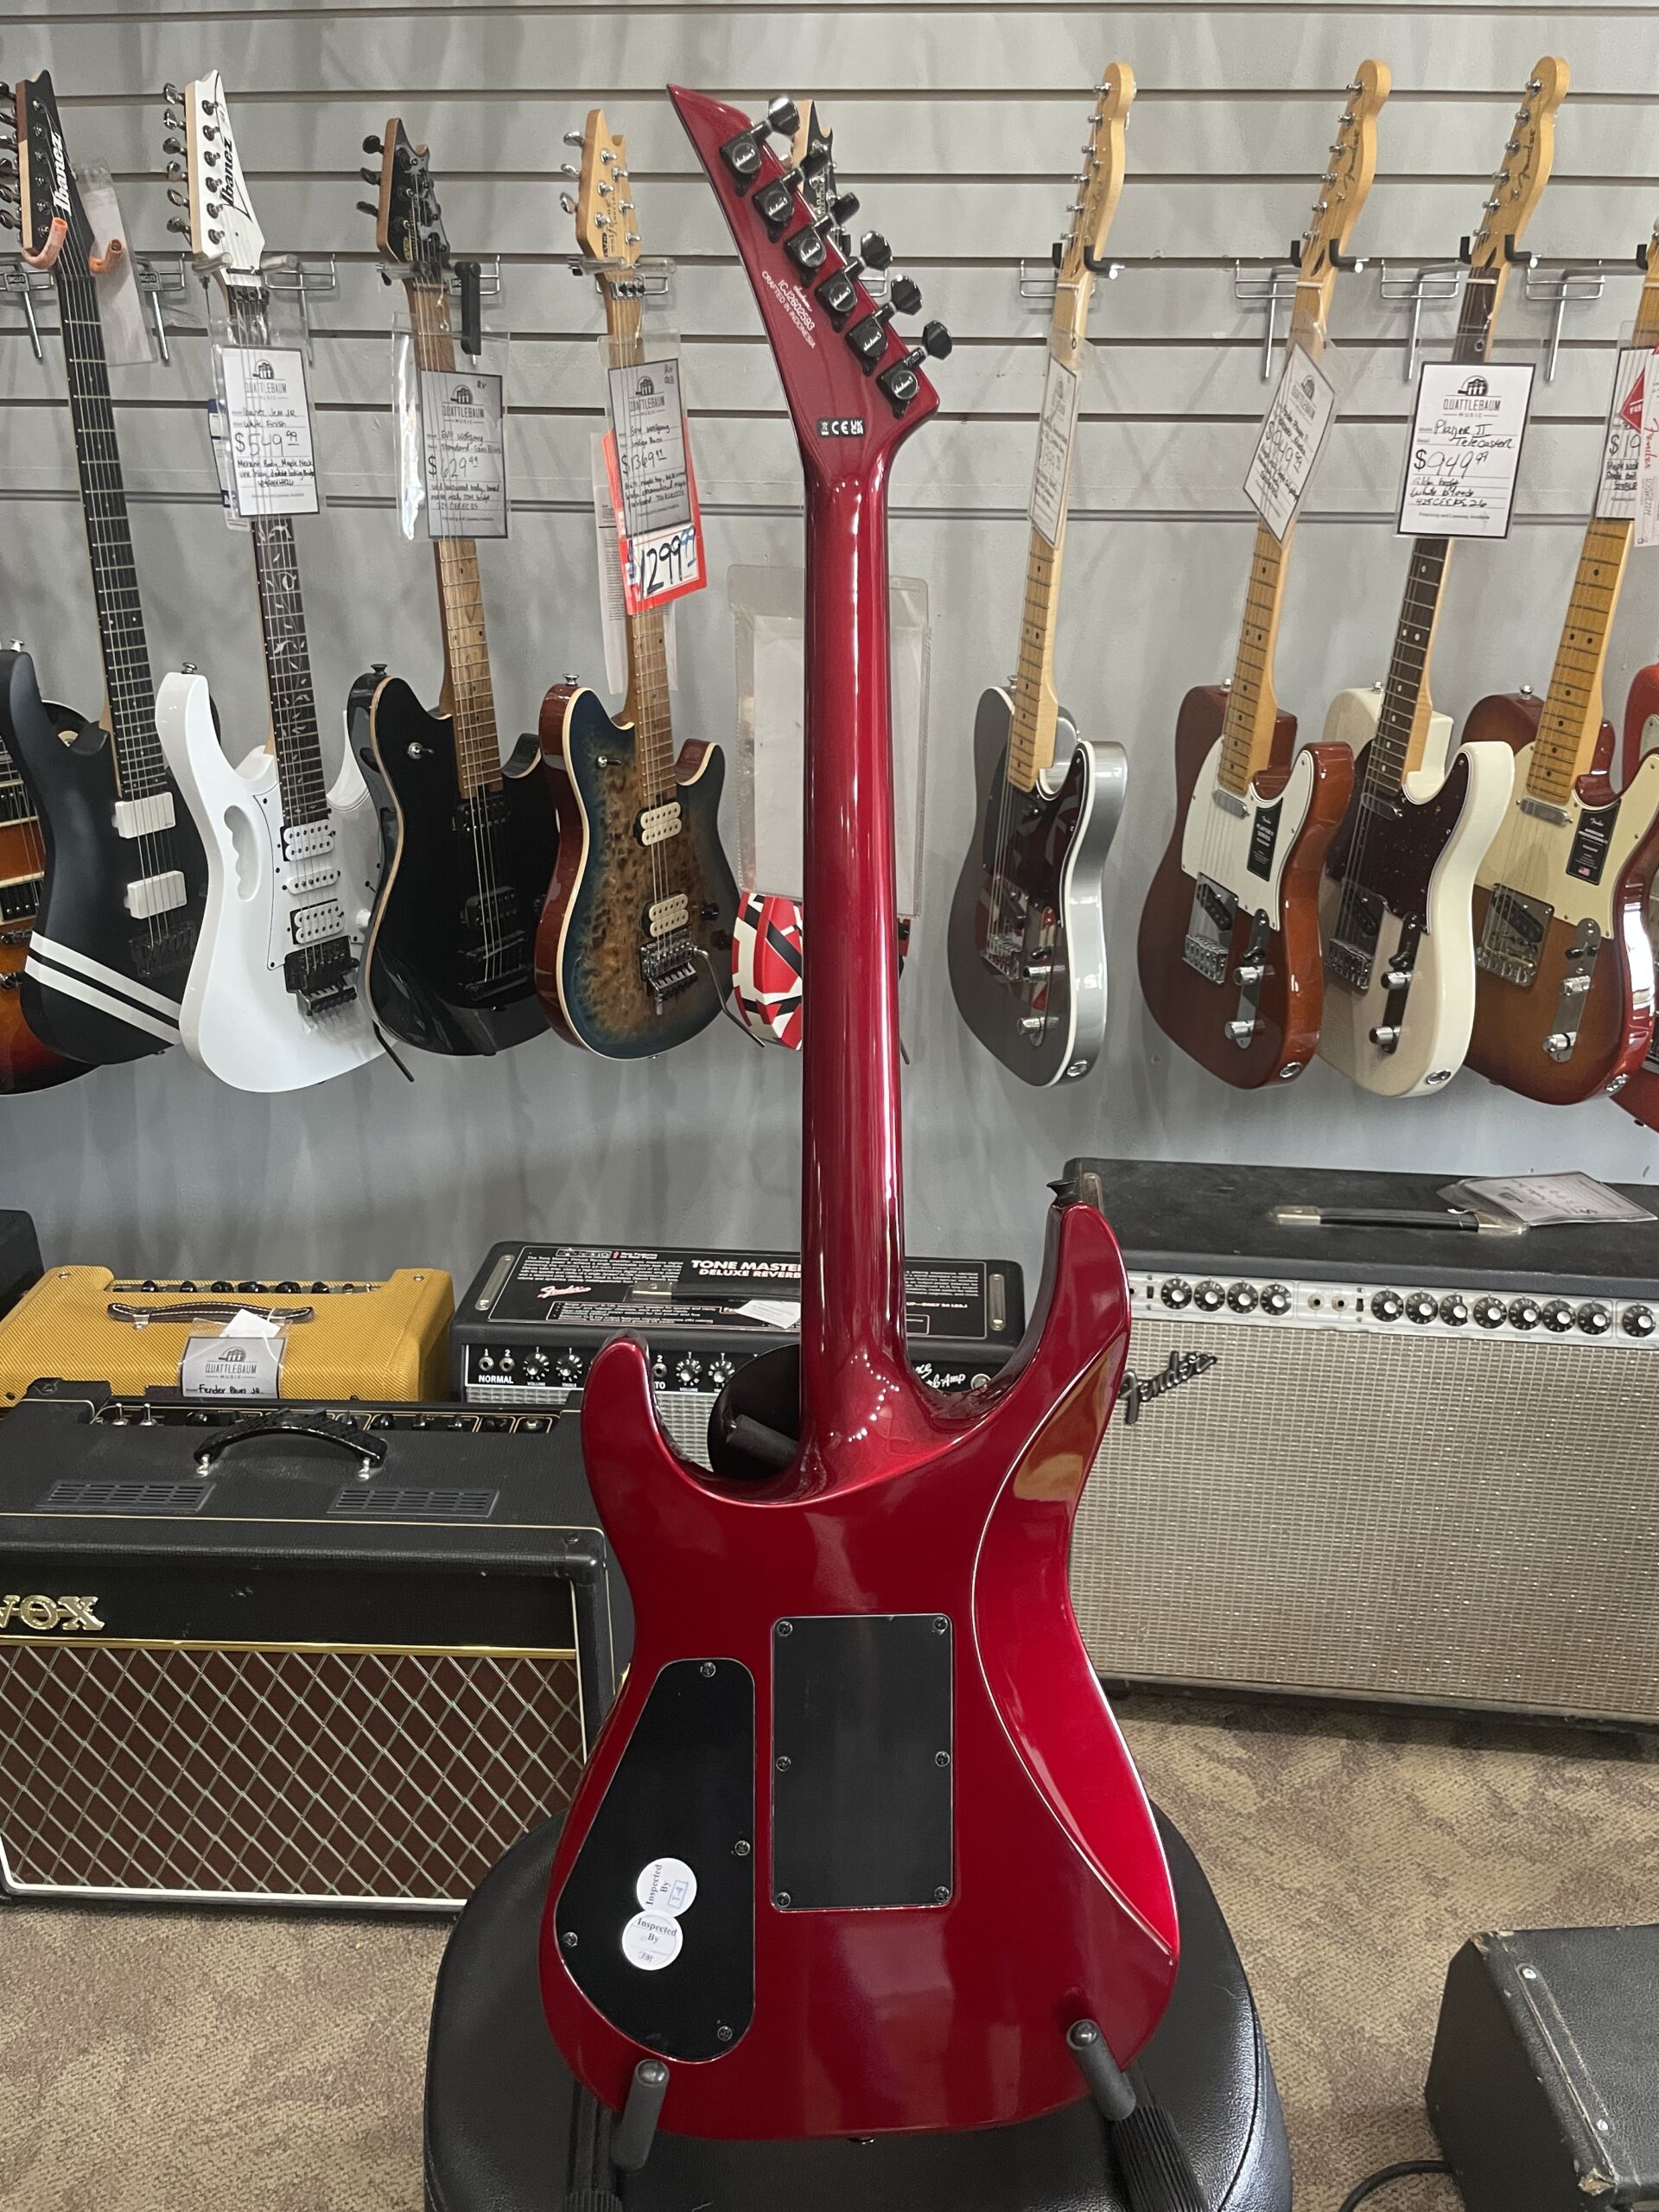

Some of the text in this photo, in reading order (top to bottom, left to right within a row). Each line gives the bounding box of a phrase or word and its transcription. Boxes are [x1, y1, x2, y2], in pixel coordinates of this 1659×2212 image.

[51, 130, 72, 216] Ibanez
[220, 137, 234, 208] Ibanez
[762, 270, 785, 303] CRAFTED
[789, 311, 816, 349] INDONESIA
[1443, 399, 1501, 410] QUATTLEBAUM
[442, 405, 484, 418] QUATTLEBAUM
[691, 1260, 737, 1269] TONE
[484, 1348, 489, 1357] 1
[657, 1354, 663, 1363] 2
[206, 1363, 257, 1374] QUATTLEBAUM
[478, 1375, 513, 1384] NORMAL
[198, 1383, 226, 1394] Fender
[646, 1864, 662, 1905] Inspected
[660, 1881, 671, 1892] By
[638, 1917, 677, 1936] Inspected
[648, 1932, 659, 1943] By
